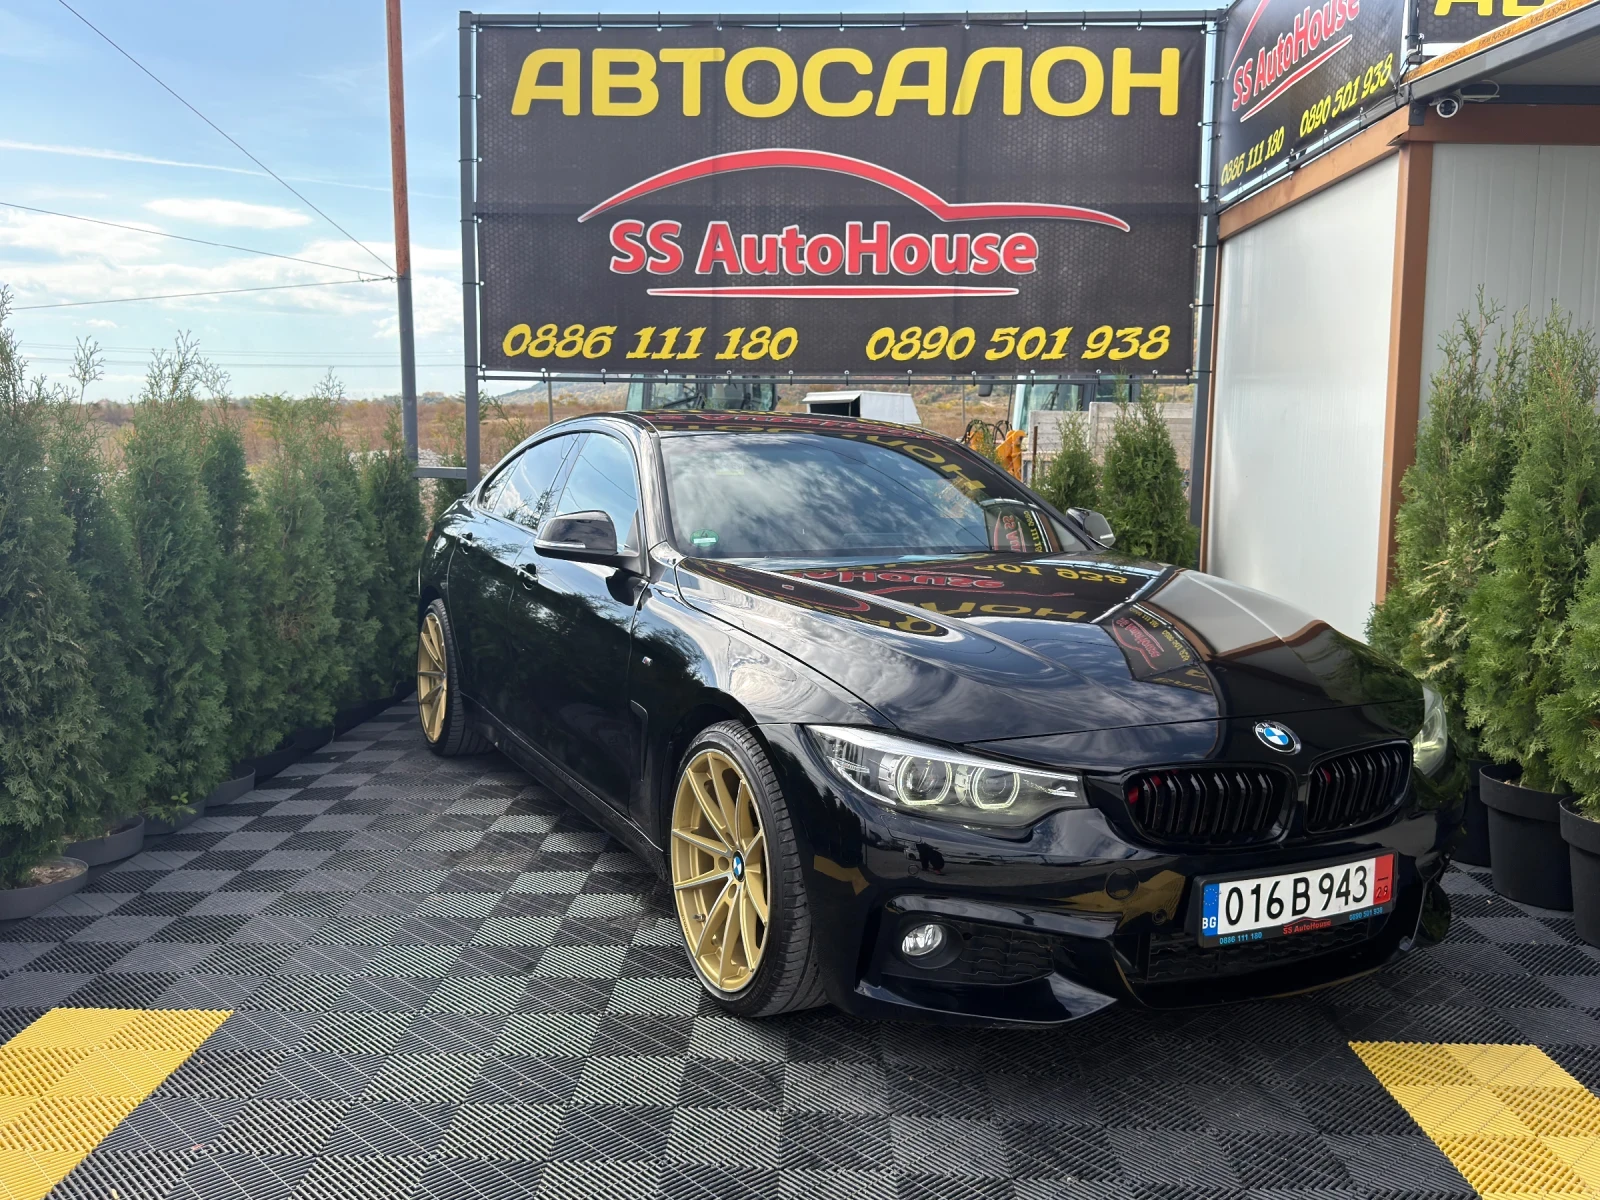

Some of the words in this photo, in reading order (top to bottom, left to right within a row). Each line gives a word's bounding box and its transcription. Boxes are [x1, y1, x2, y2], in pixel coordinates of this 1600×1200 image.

[511, 46, 1181, 118] АВТОСАЛОН
[1232, 57, 1253, 111] SS
[1300, 95, 1331, 138] 0890
[1331, 75, 1361, 119] 501
[1361, 53, 1394, 99] 938
[1220, 152, 1244, 187] 0886
[1245, 141, 1264, 173] 111
[1264, 126, 1285, 161] 180
[609, 219, 684, 277] SS
[695, 219, 1040, 277] AutoHouse
[502, 323, 617, 360] 0886
[626, 325, 707, 361] 111
[715, 325, 799, 361] 180
[865, 325, 977, 361] 0890
[984, 325, 1073, 362] 501
[1080, 324, 1171, 362] 938
[1202, 917, 1217, 930] BG
[1238, 934, 1249, 942] 111
[1283, 926, 1294, 935] SS
[1294, 919, 1332, 933] AutoHouse
